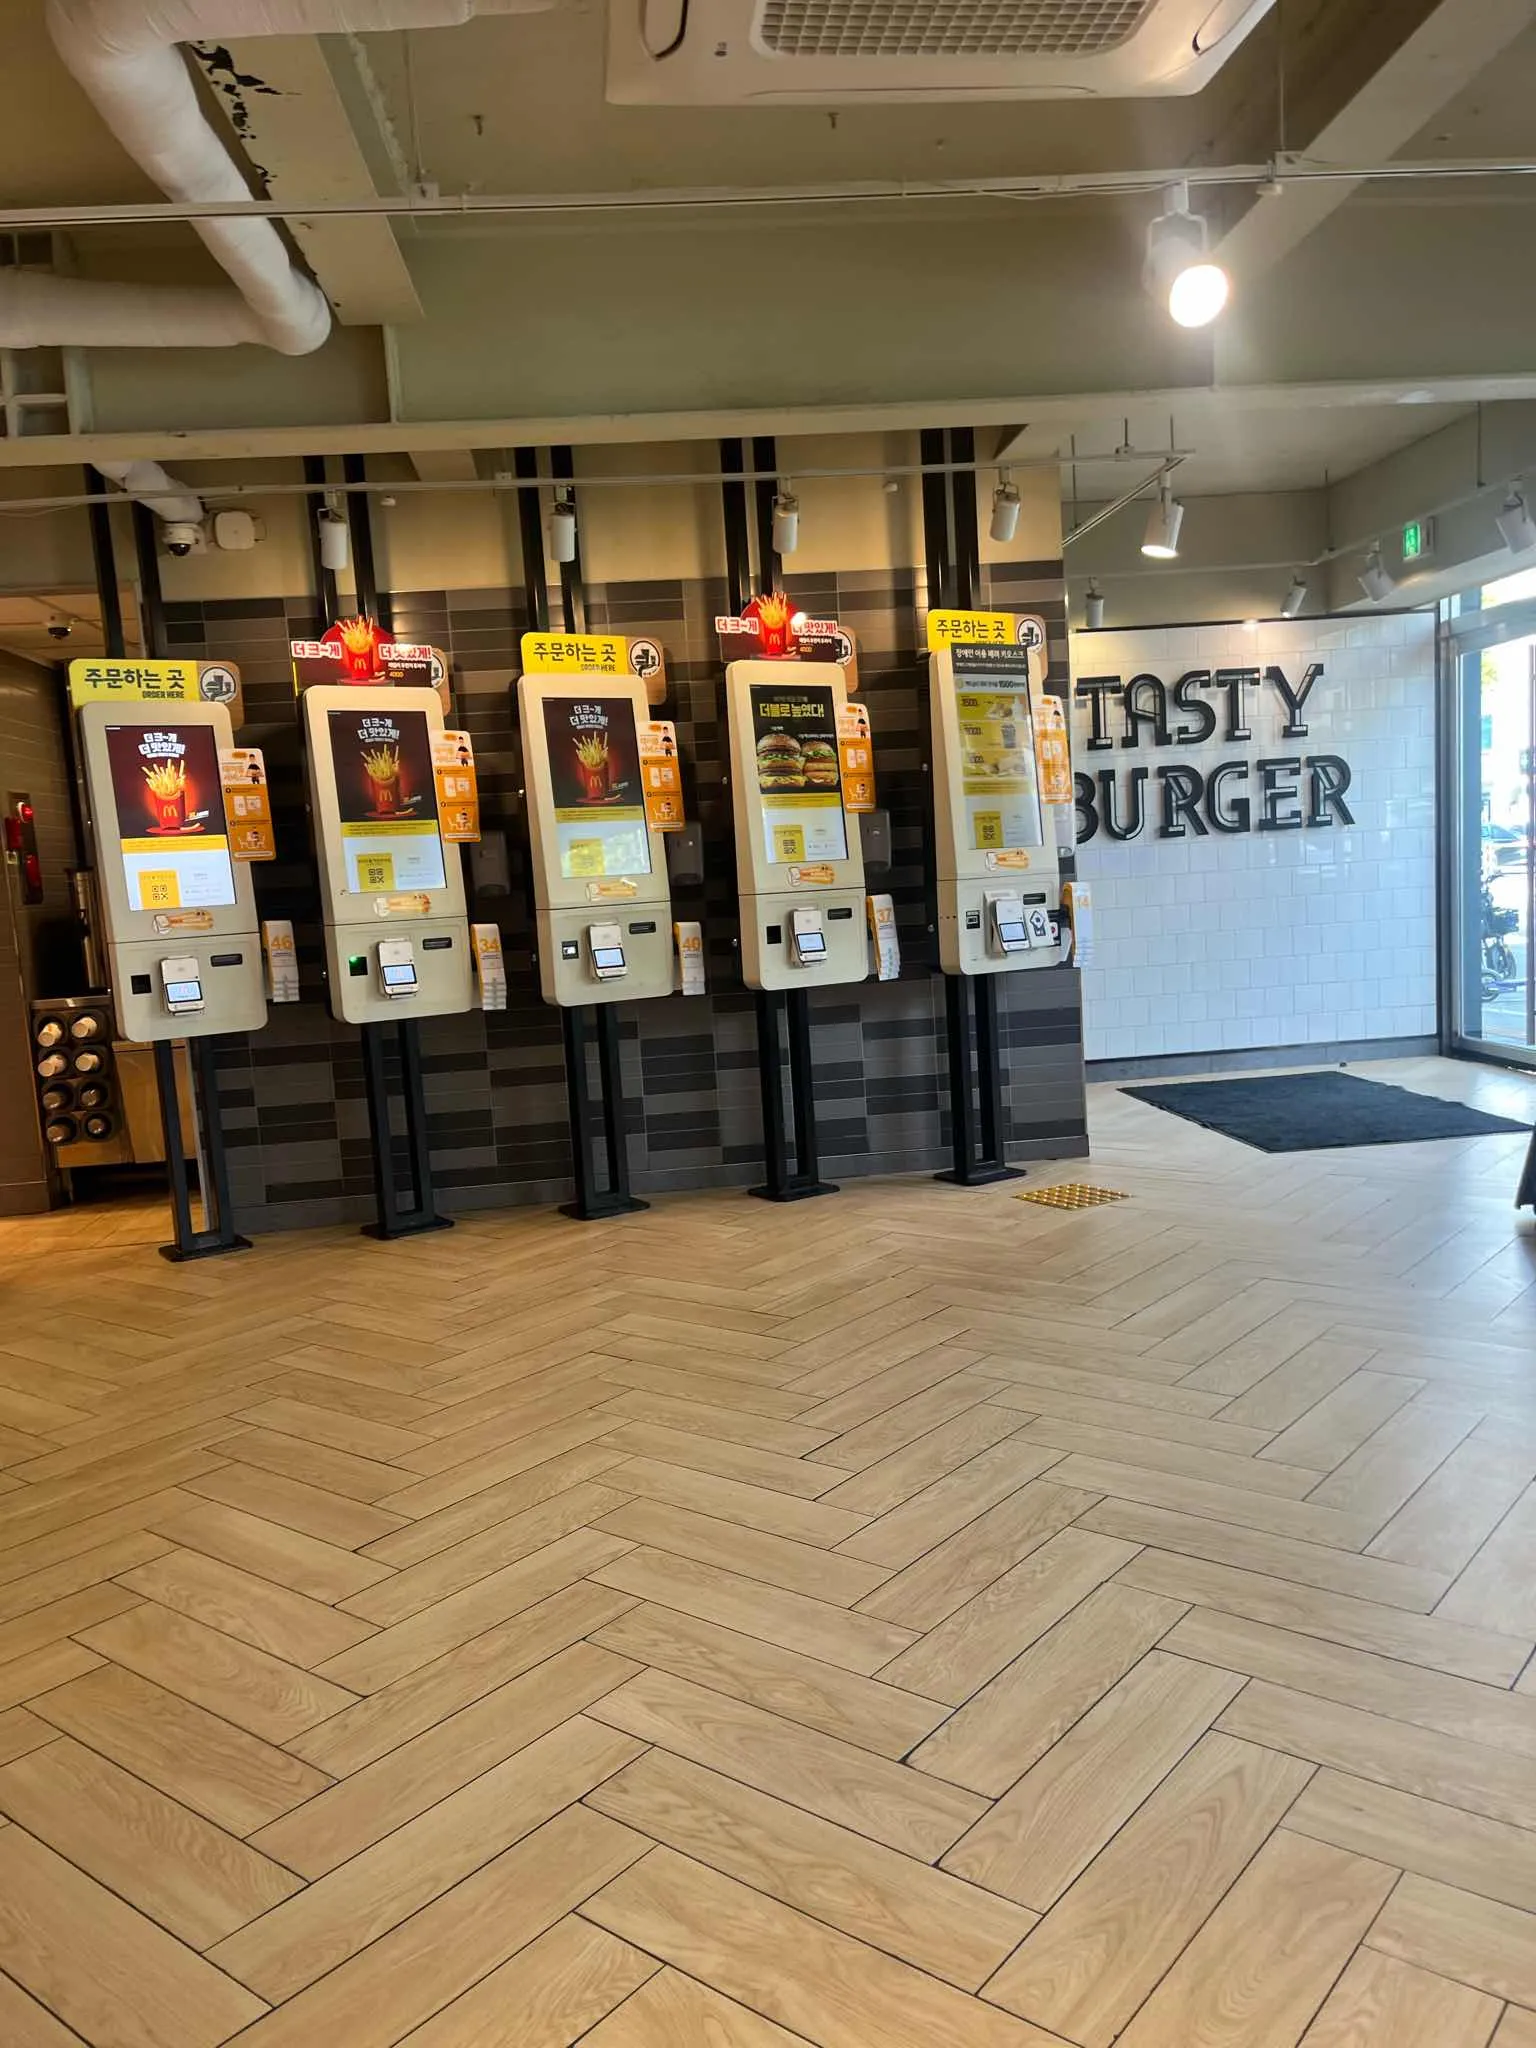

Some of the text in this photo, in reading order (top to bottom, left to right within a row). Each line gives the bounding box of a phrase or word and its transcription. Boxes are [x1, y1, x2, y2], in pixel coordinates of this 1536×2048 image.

[716, 618, 727, 632] 더
[803, 621, 837, 634] 맛있게!
[937, 620, 1005, 639] 주문하는 곳
[293, 642, 306, 657] 더
[380, 645, 393, 658] 더
[533, 642, 616, 663] 주문하는 곳
[85, 669, 185, 689] 주문하는 곳
[166, 690, 185, 698] HERE
[574, 705, 581, 714] 더
[760, 703, 791, 718] 더블로
[1076, 664, 1324, 750] TASTY
[362, 719, 370, 728] 더
[569, 716, 578, 726] 더
[144, 733, 153, 743] 더
[357, 729, 369, 739] 더
[138, 744, 149, 755] 더
[1075, 755, 1355, 844] BURGER
[271, 935, 292, 950] 46
[480, 938, 500, 952] 34
